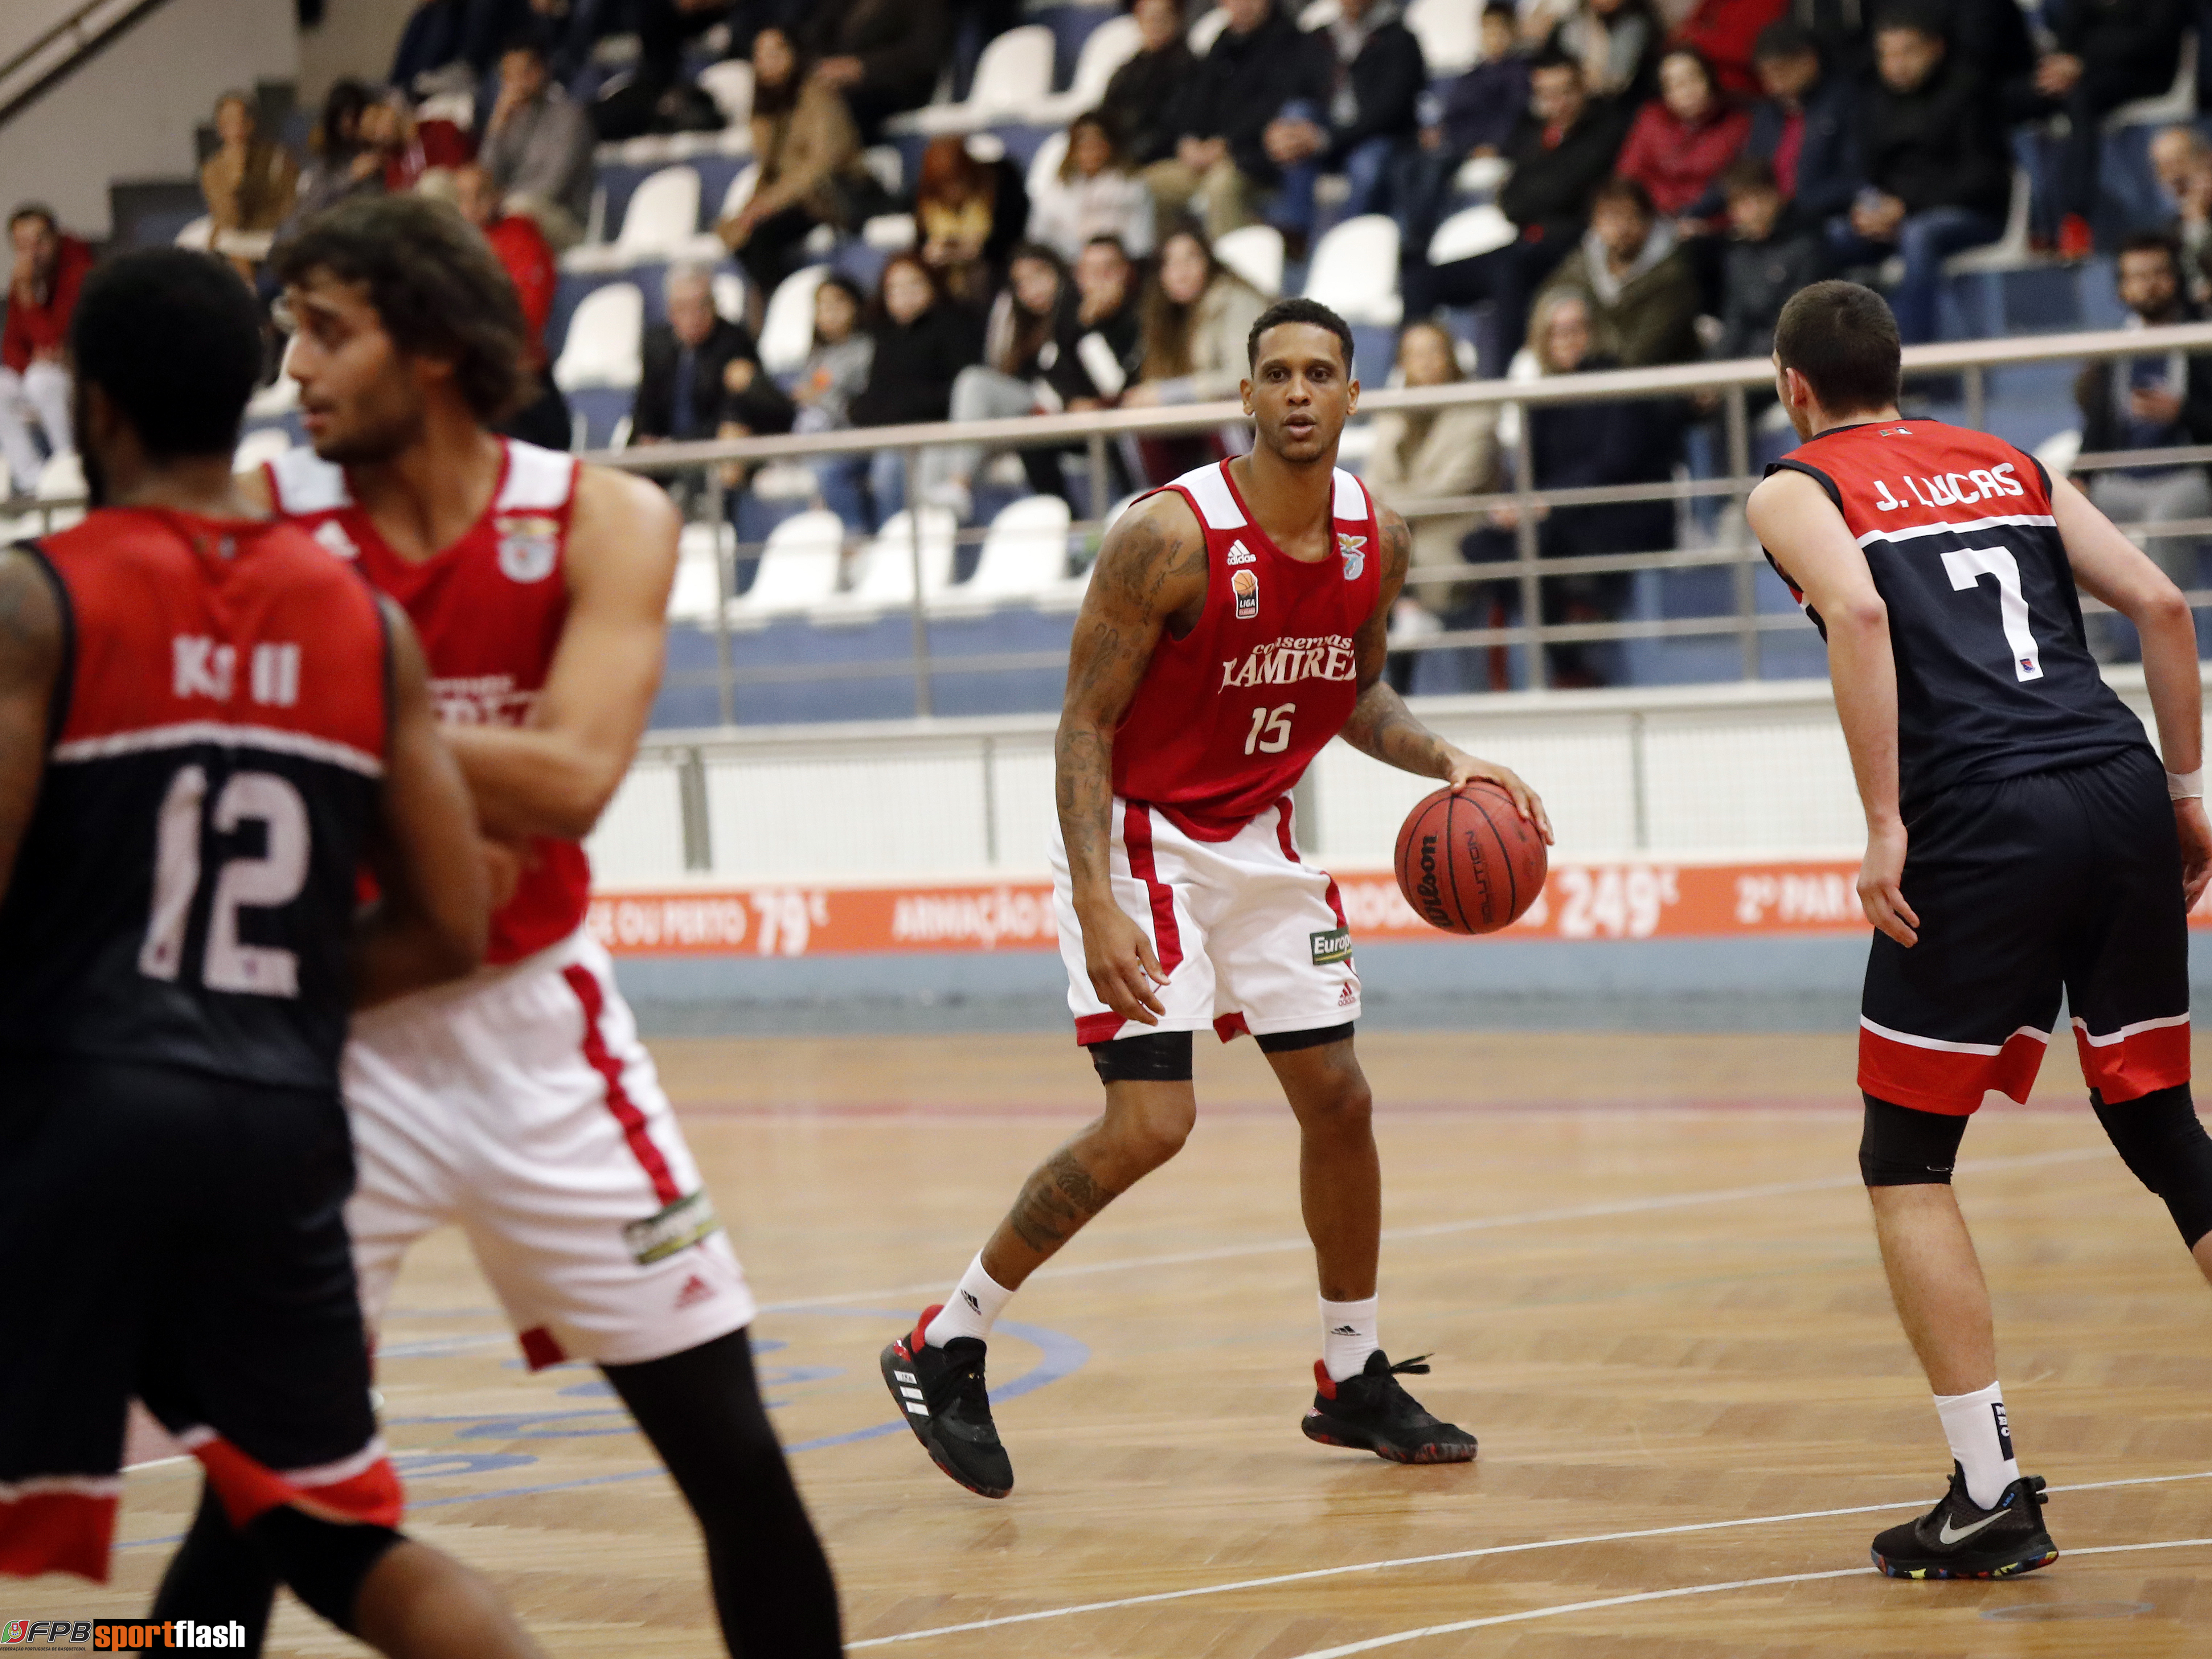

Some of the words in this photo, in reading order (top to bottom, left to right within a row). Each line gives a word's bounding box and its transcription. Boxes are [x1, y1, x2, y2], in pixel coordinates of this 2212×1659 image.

[1874, 480, 1909, 511] J.
[1904, 462, 2024, 507] LUCAS
[1240, 598, 1255, 609] LIGA
[1940, 546, 2044, 683] 7
[1244, 702, 1296, 755] 15
[137, 762, 312, 999] 12
